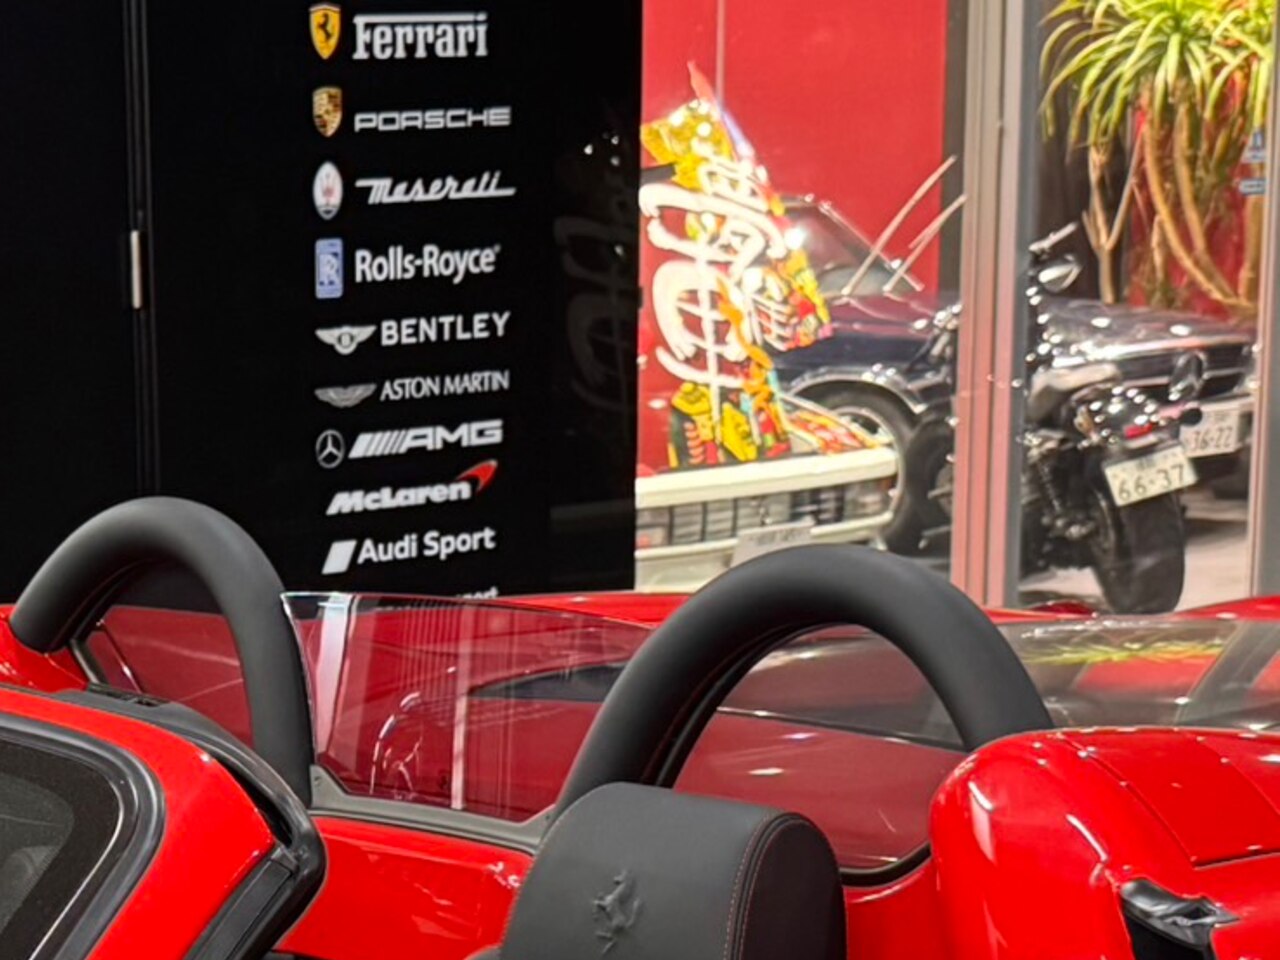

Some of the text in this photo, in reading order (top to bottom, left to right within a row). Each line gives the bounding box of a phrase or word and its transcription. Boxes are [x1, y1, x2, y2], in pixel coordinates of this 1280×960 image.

[352, 12, 489, 60] Ferrari
[354, 106, 512, 132] PORSCHE
[355, 170, 516, 204] Maserati
[380, 311, 511, 346] BENTLEY
[380, 370, 510, 401] ASTON MARTIN
[325, 481, 471, 515] McLaren
[357, 527, 497, 564] Audi Sport
